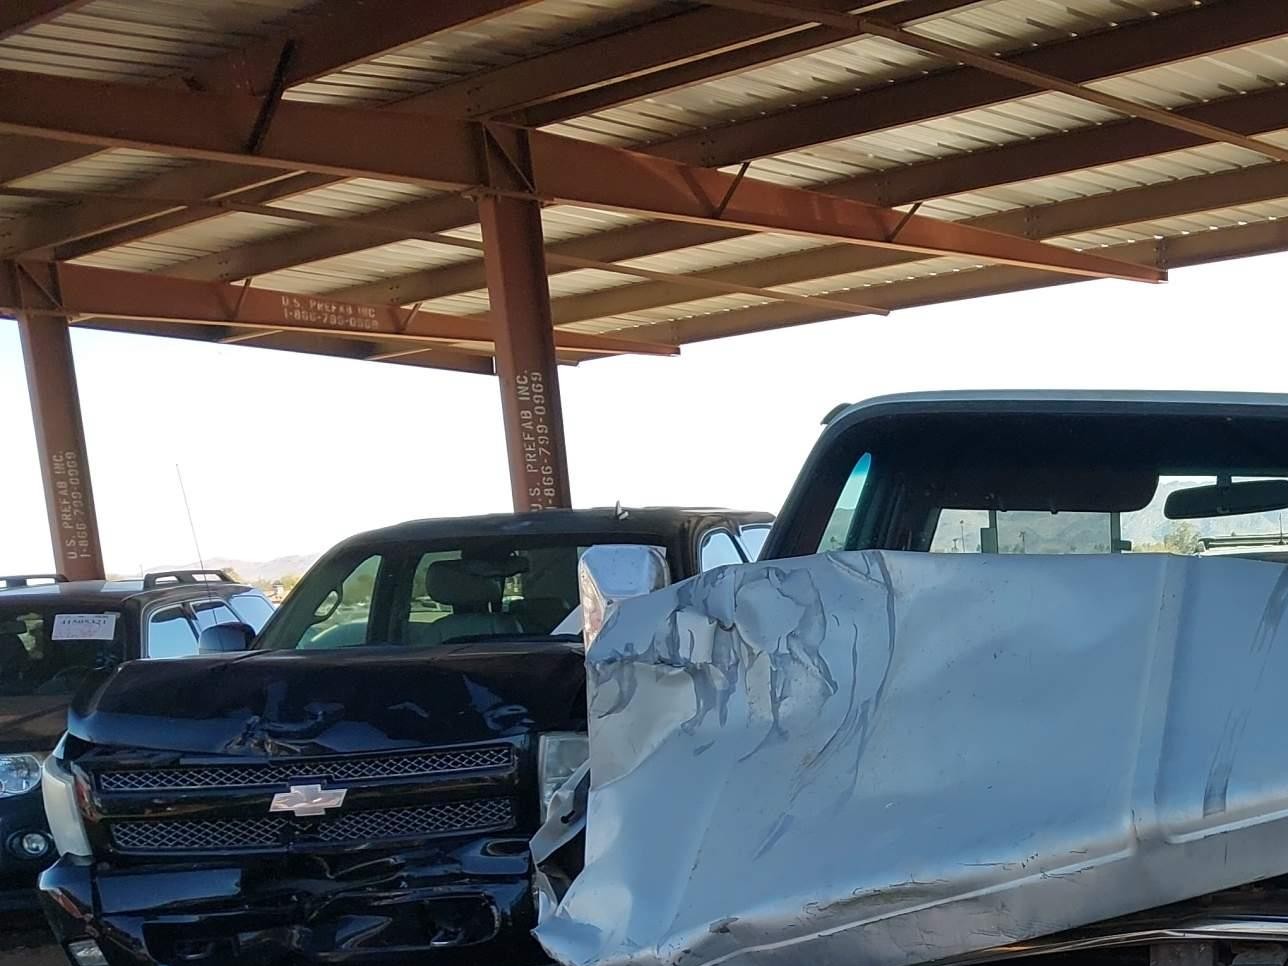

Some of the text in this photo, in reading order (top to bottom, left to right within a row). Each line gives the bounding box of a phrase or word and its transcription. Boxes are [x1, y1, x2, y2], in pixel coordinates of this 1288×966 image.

[516, 369, 530, 401] INC.
[520, 409, 539, 473] PREFAB
[56, 480, 74, 529] PREFAB
